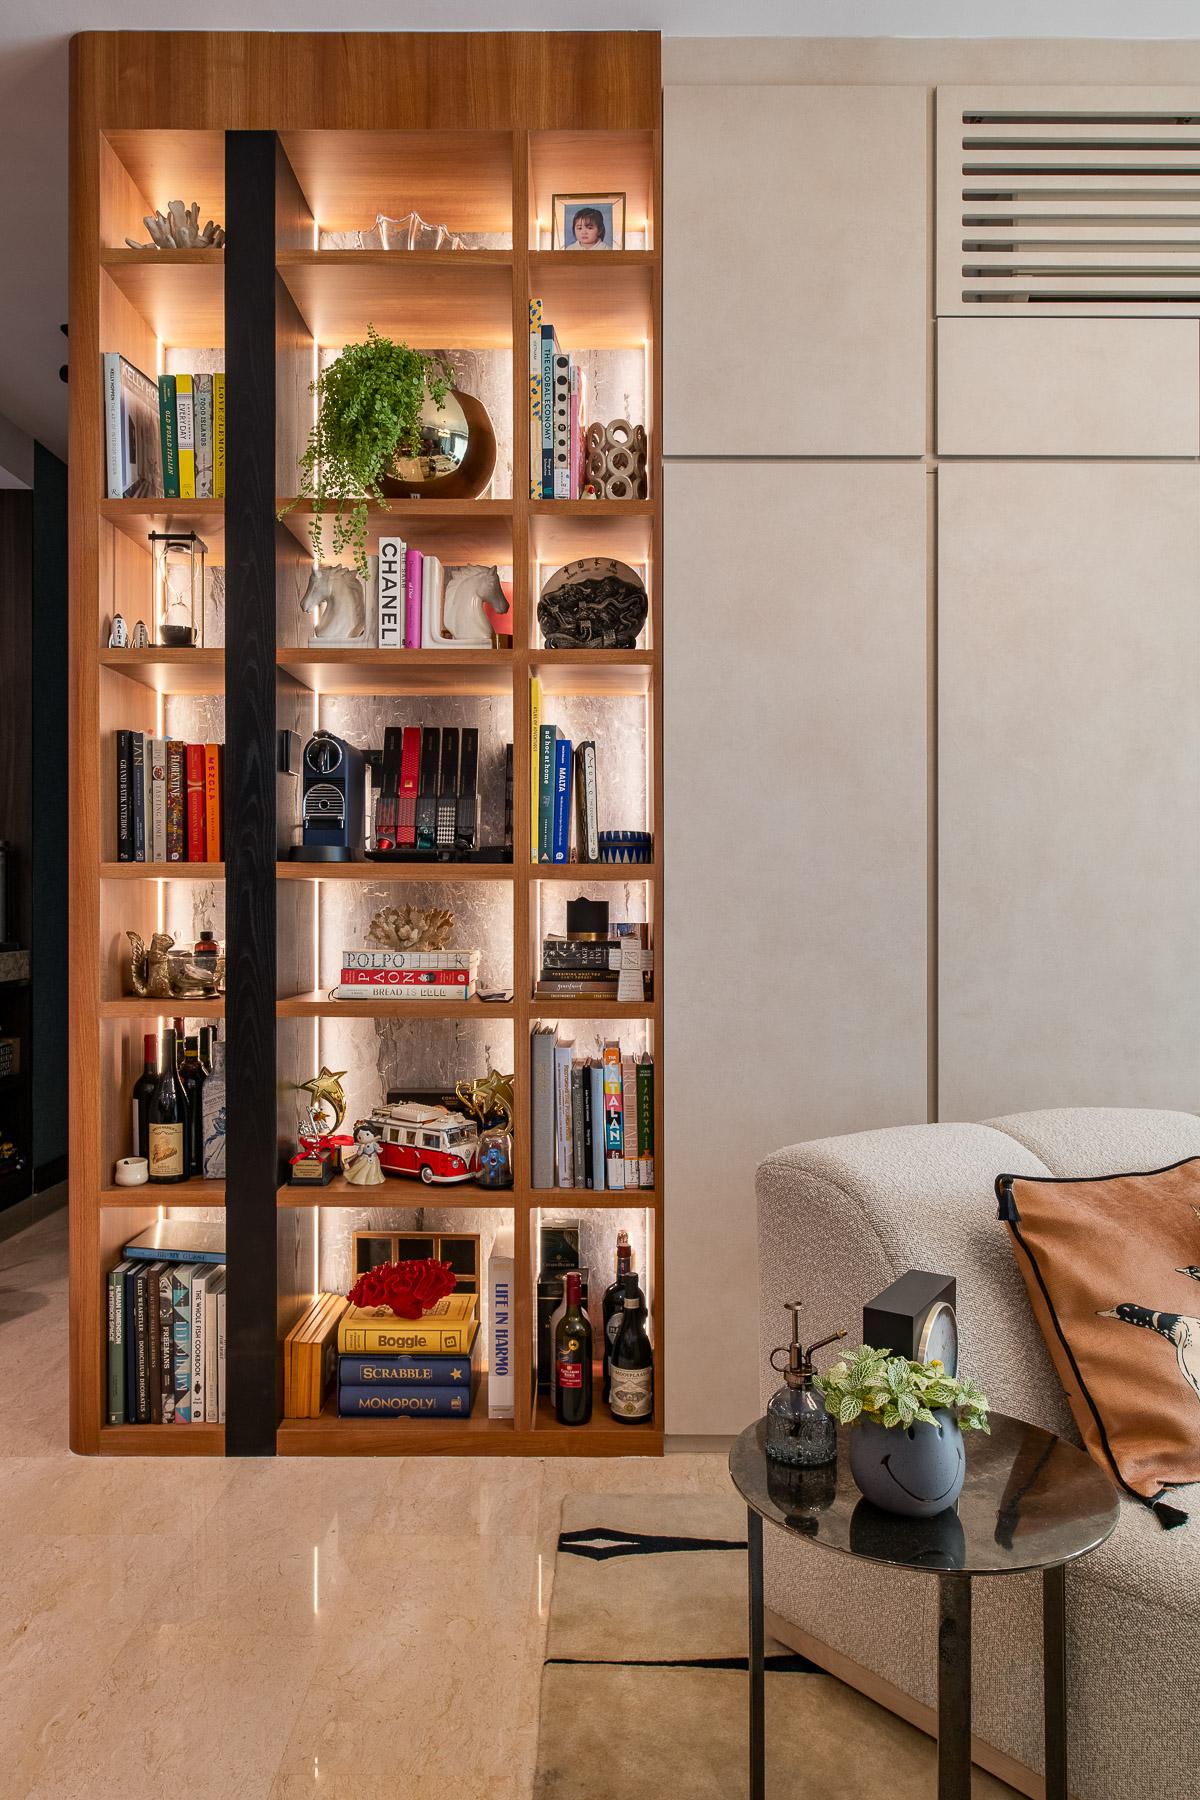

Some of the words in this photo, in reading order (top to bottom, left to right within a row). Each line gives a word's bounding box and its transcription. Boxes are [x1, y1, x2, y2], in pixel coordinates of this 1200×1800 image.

[381, 542, 398, 640] CHANEL
[545, 731, 551, 739] ad
[133, 740, 143, 766] JAN
[171, 755, 180, 797] FLORENTINE
[348, 953, 404, 967] POLPO
[623, 1070, 638, 1101] RICE
[495, 1283, 508, 1307] LIFE
[495, 1312, 508, 1324] IN
[378, 1335, 426, 1349] Boggle
[495, 1330, 508, 1376] HARMO
[362, 1368, 432, 1379] SCRABBLE
[359, 1398, 434, 1409] MONOPOLY
